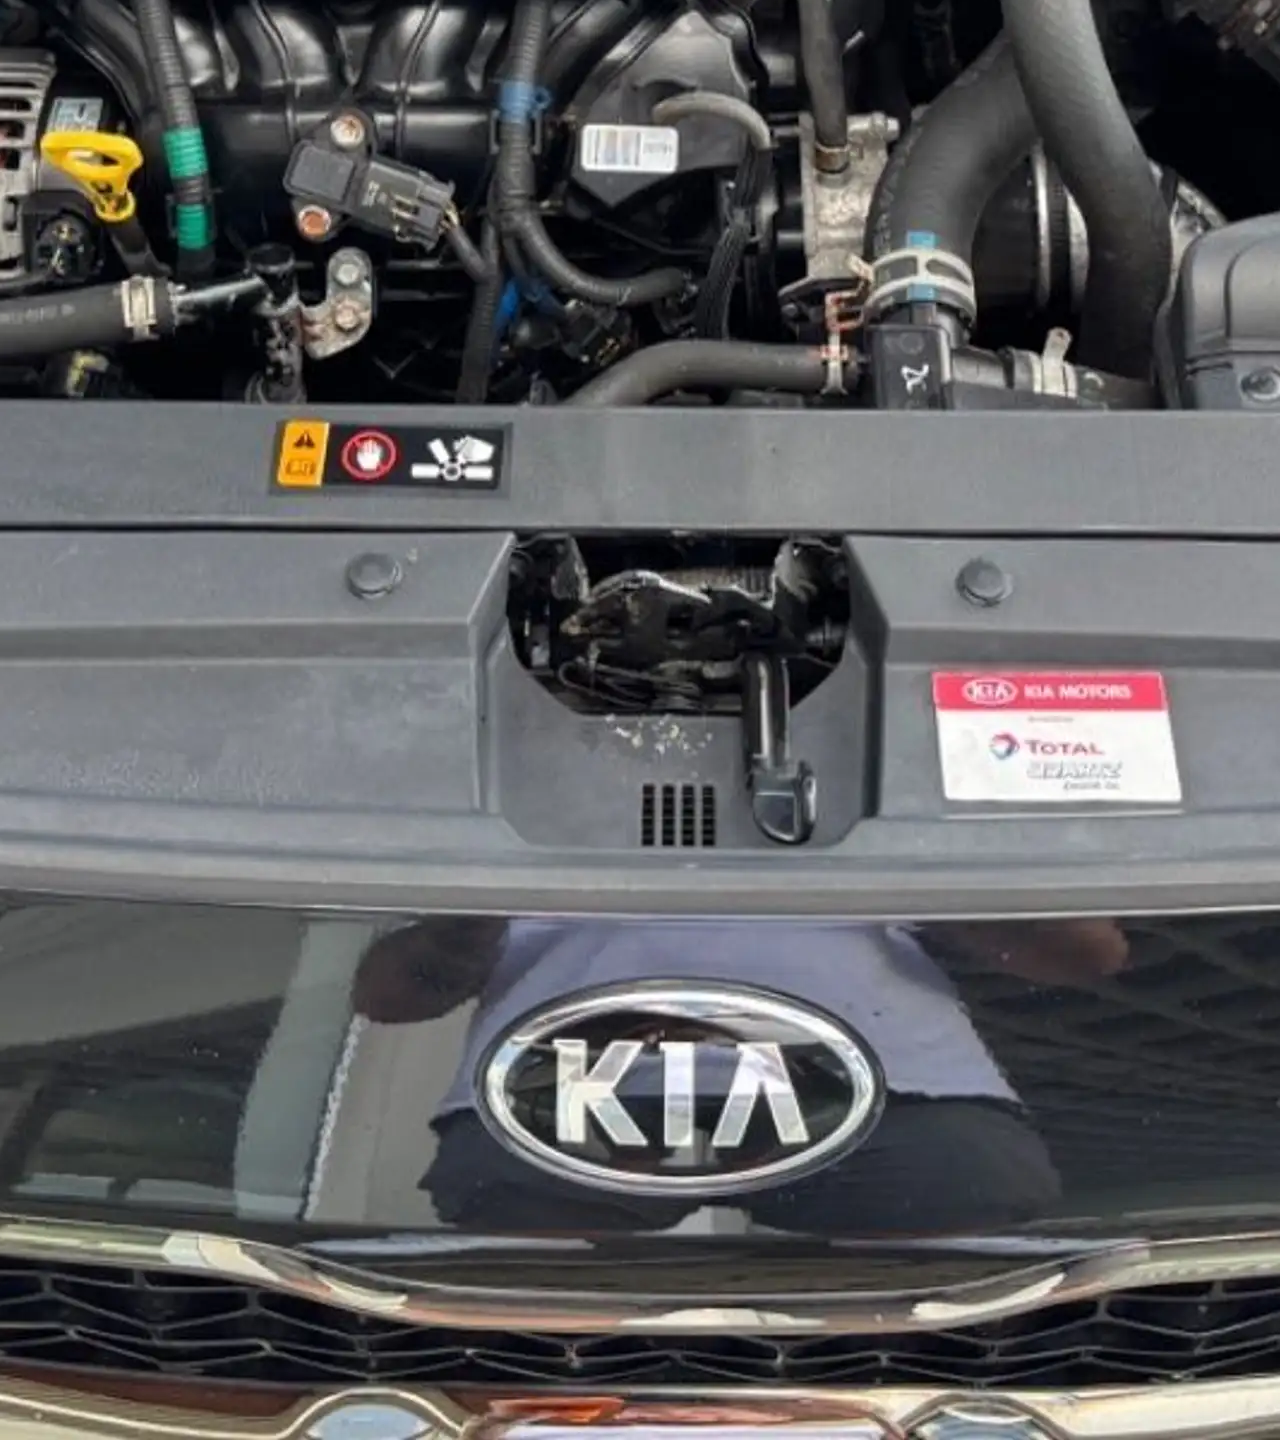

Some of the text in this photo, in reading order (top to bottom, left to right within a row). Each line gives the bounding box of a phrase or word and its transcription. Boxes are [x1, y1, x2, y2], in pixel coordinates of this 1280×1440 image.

[971, 683, 1012, 701] KIA
[1024, 683, 1132, 700] KIA MOTORS
[1025, 739, 1106, 756] TOTAL
[552, 1038, 810, 1148] KIA
